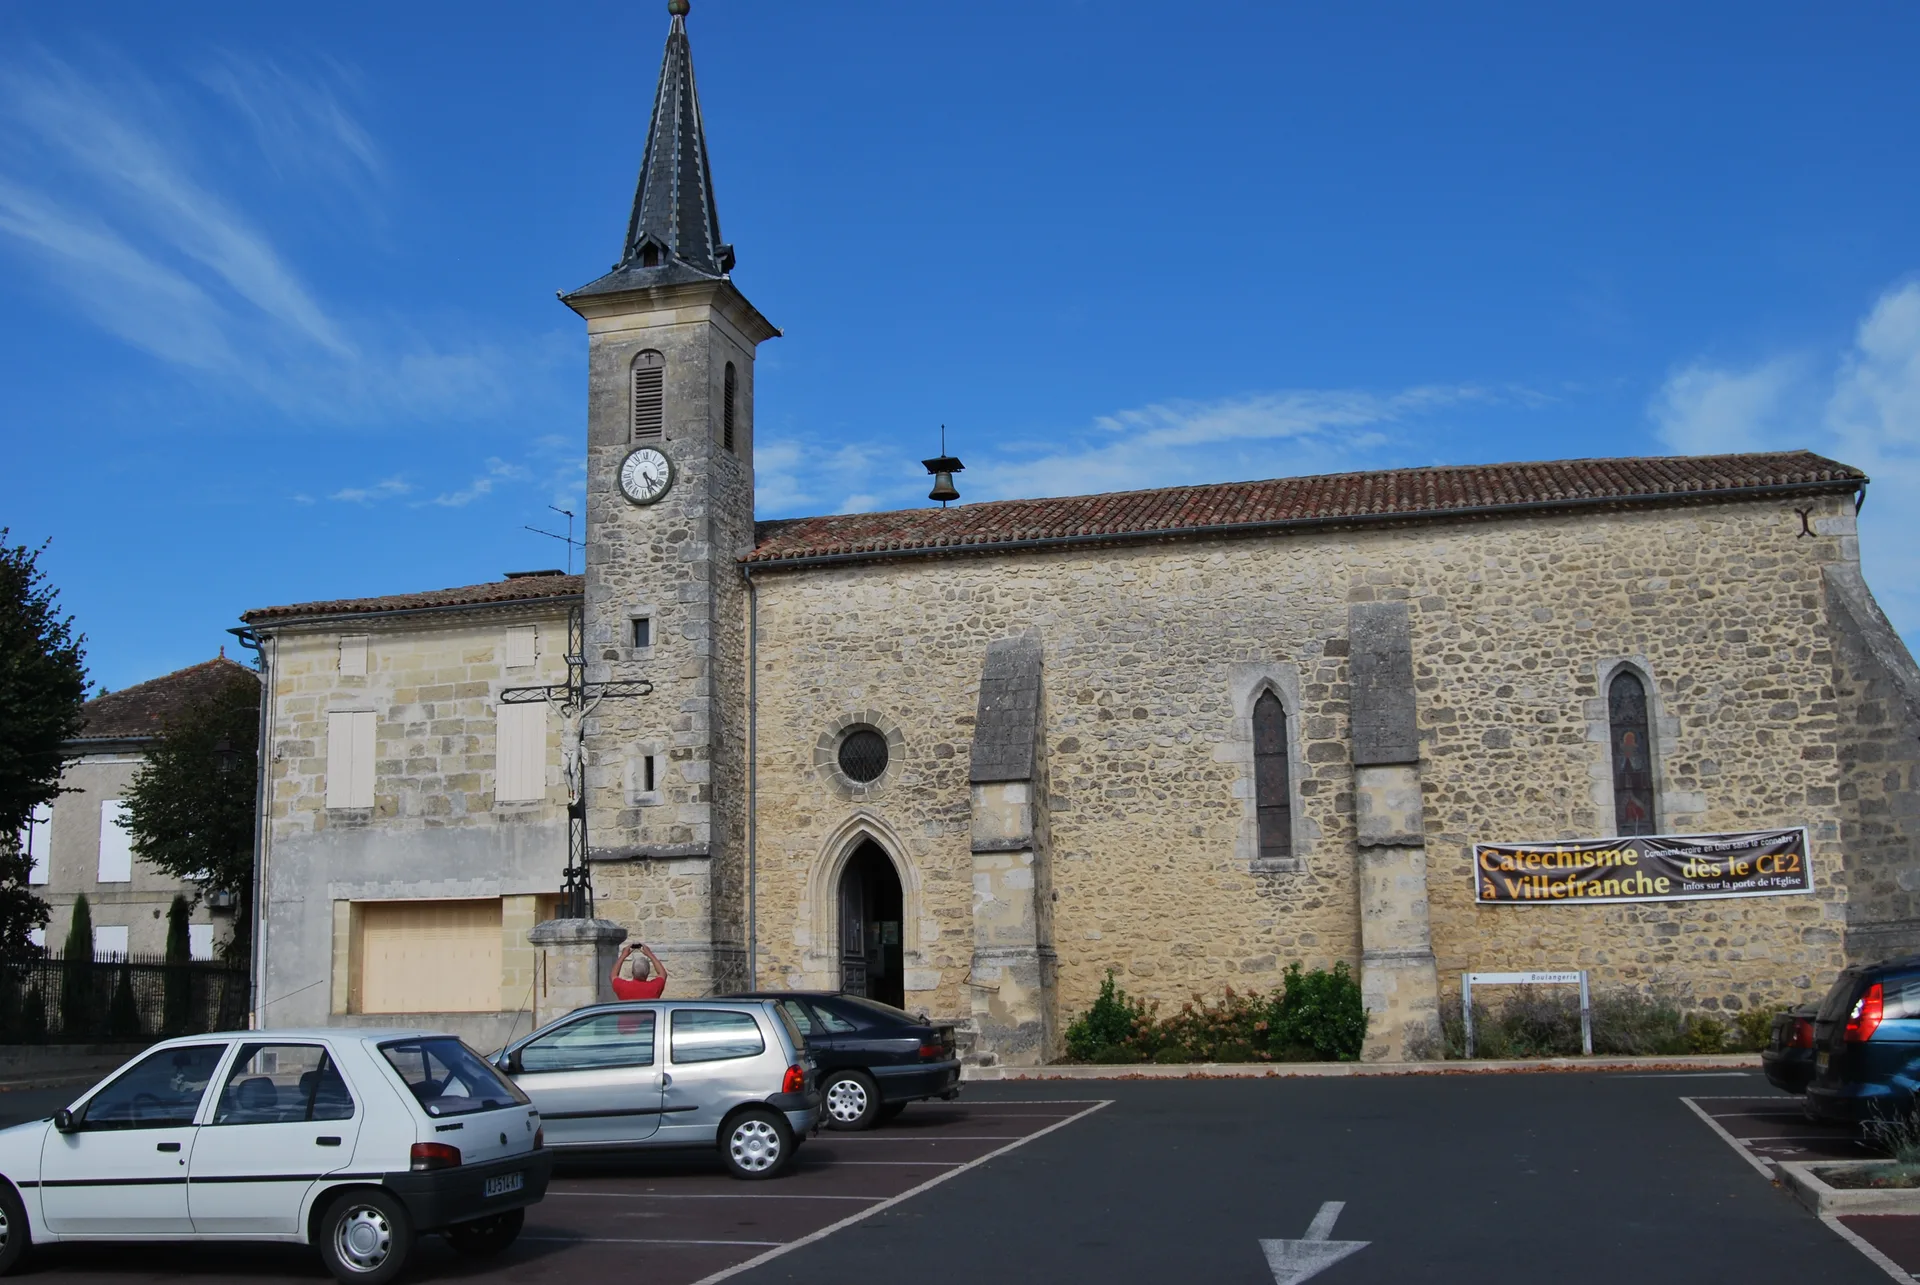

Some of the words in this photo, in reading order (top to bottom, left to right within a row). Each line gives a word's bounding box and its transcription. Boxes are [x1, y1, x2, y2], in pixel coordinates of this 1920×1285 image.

[1479, 845, 1638, 871] Catéchisme
[1644, 847, 1680, 858] Comment
[1681, 846, 1701, 855] croire
[1704, 844, 1713, 852] en
[1715, 843, 1731, 851] Dieu
[1733, 841, 1749, 849] sans
[1751, 839, 1758, 847] le
[1683, 857, 1721, 878] dès
[1728, 856, 1749, 875] le
[1756, 853, 1800, 874] CE2
[1483, 877, 1497, 899] à
[1504, 870, 1670, 899] Villefranche
[1683, 882, 1705, 890] Infos
[1706, 882, 1720, 890] sur
[1722, 880, 1731, 889] la
[1733, 879, 1755, 890] porte
[1758, 878, 1768, 887] de
[1531, 973, 1577, 981] Boulangerie
